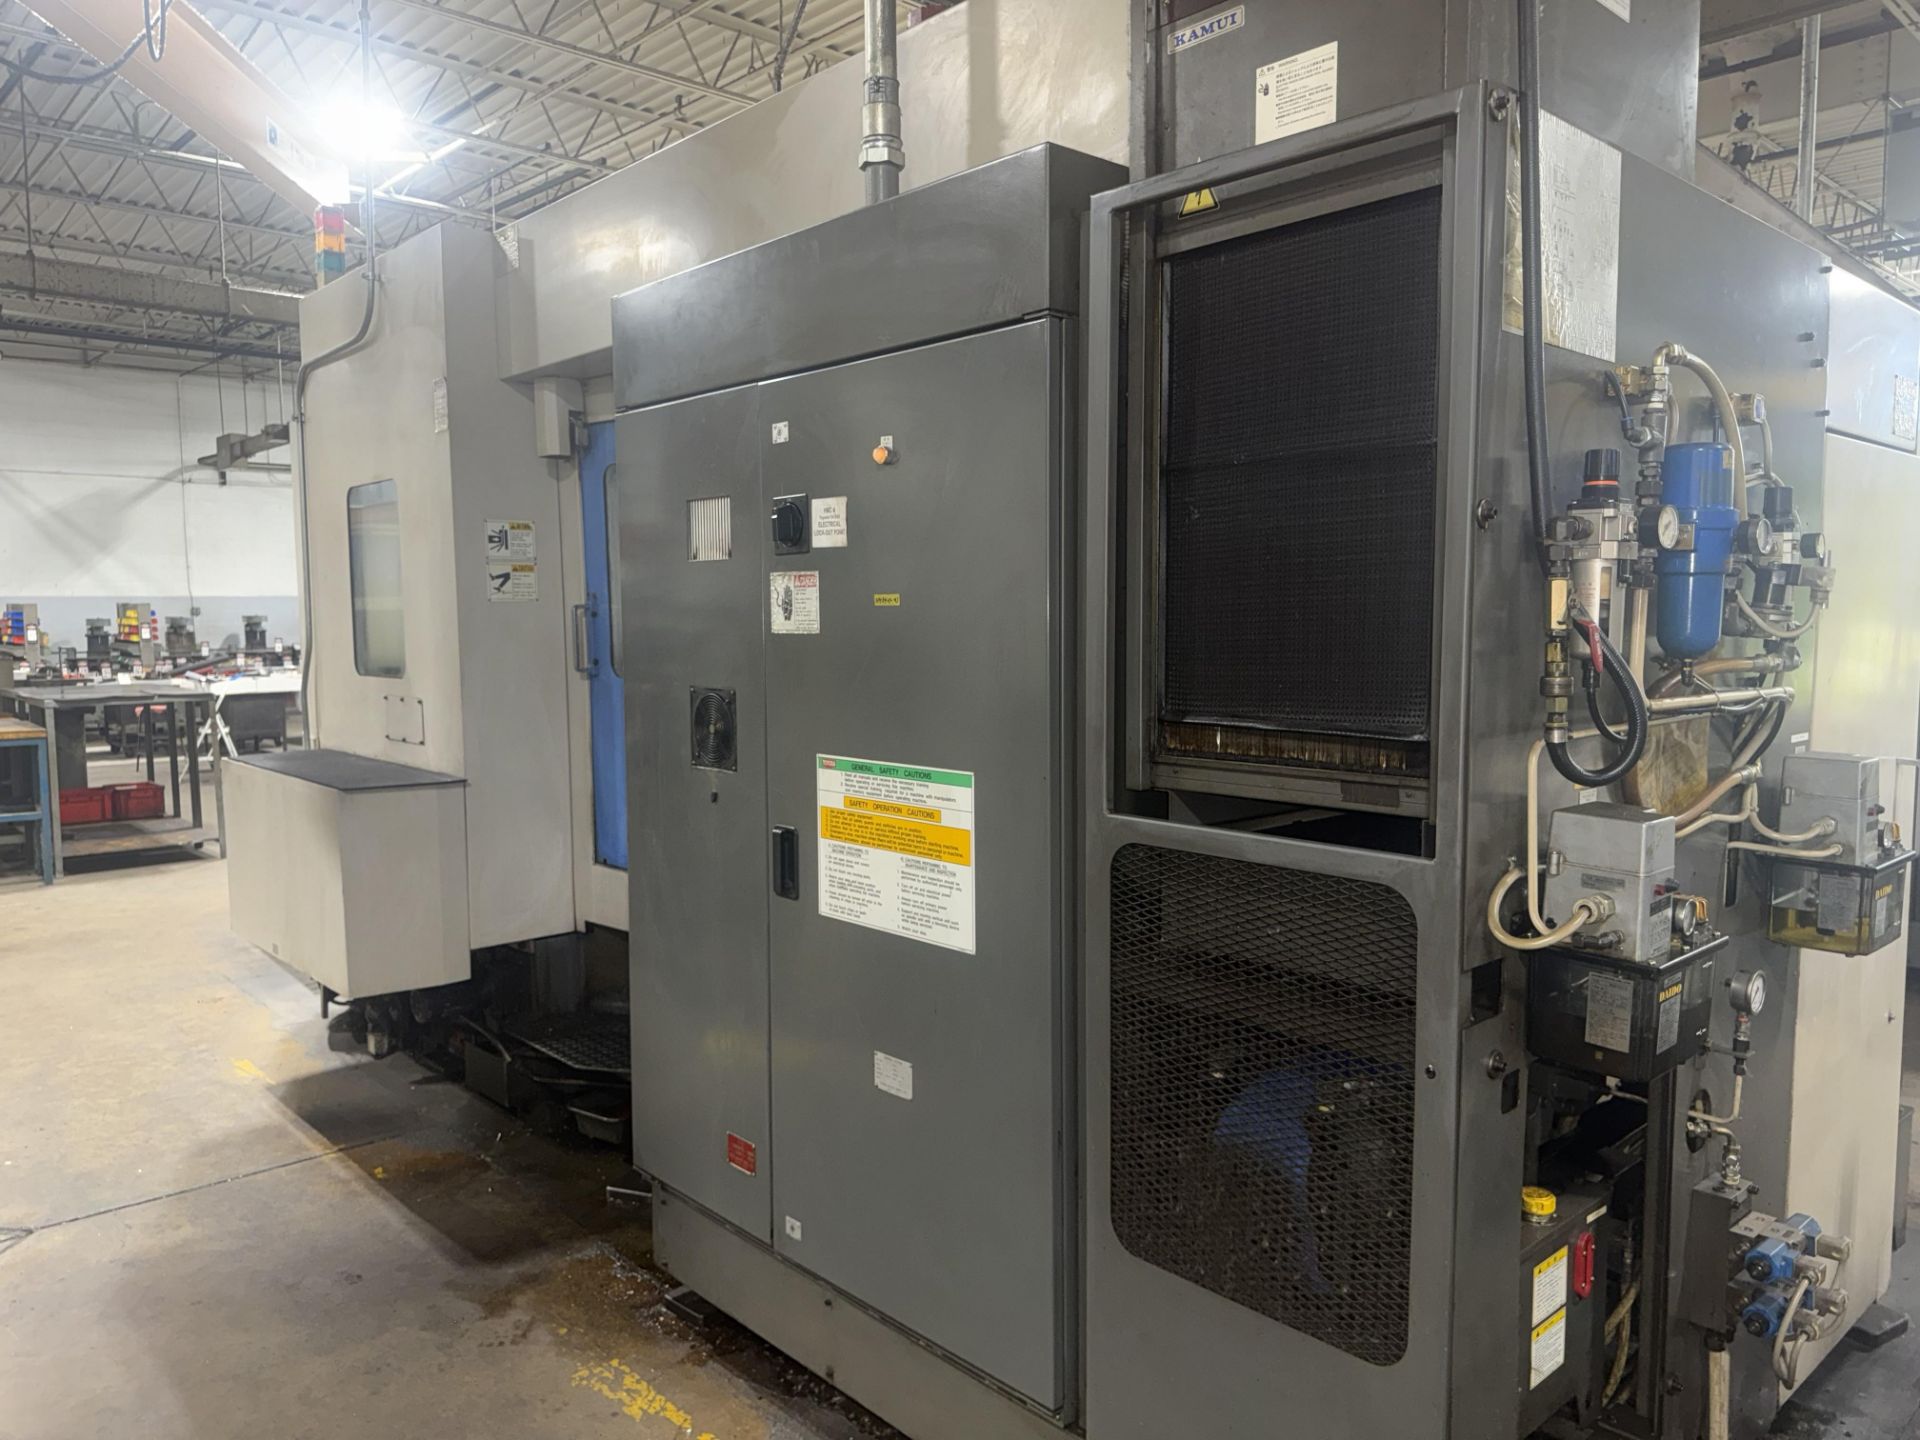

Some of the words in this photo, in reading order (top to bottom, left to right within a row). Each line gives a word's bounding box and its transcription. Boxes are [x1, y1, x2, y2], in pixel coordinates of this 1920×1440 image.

[1173, 12, 1238, 48] KAMUI
[851, 763, 875, 774] GENERAL
[879, 766, 899, 776] SAFETY
[903, 768, 932, 780] CAUTIONS
[849, 799, 869, 809] SAFETY
[872, 802, 903, 815] OPERATION
[907, 806, 935, 820] CAUTIONS
